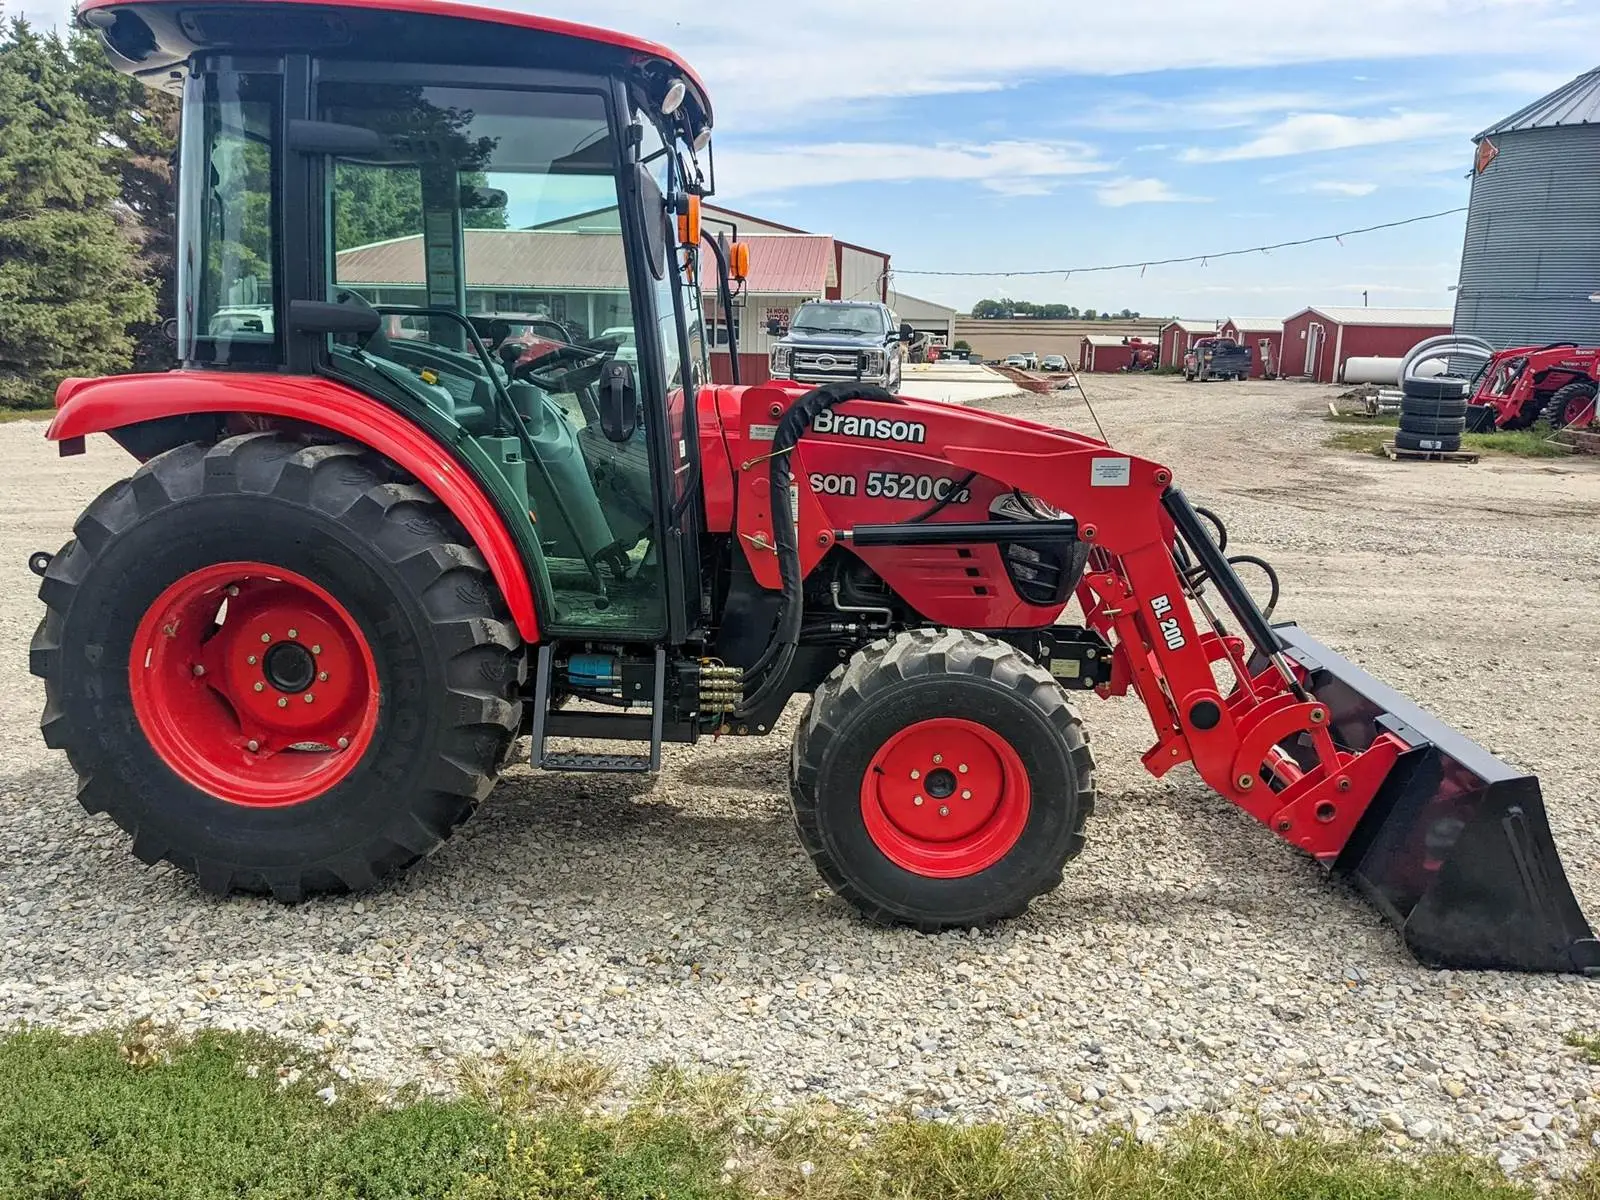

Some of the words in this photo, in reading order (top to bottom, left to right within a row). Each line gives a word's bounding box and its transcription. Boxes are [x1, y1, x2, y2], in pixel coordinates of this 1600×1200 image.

[812, 407, 927, 443] Branson
[1150, 594, 1172, 619] BL
[1159, 618, 1186, 650] 200
